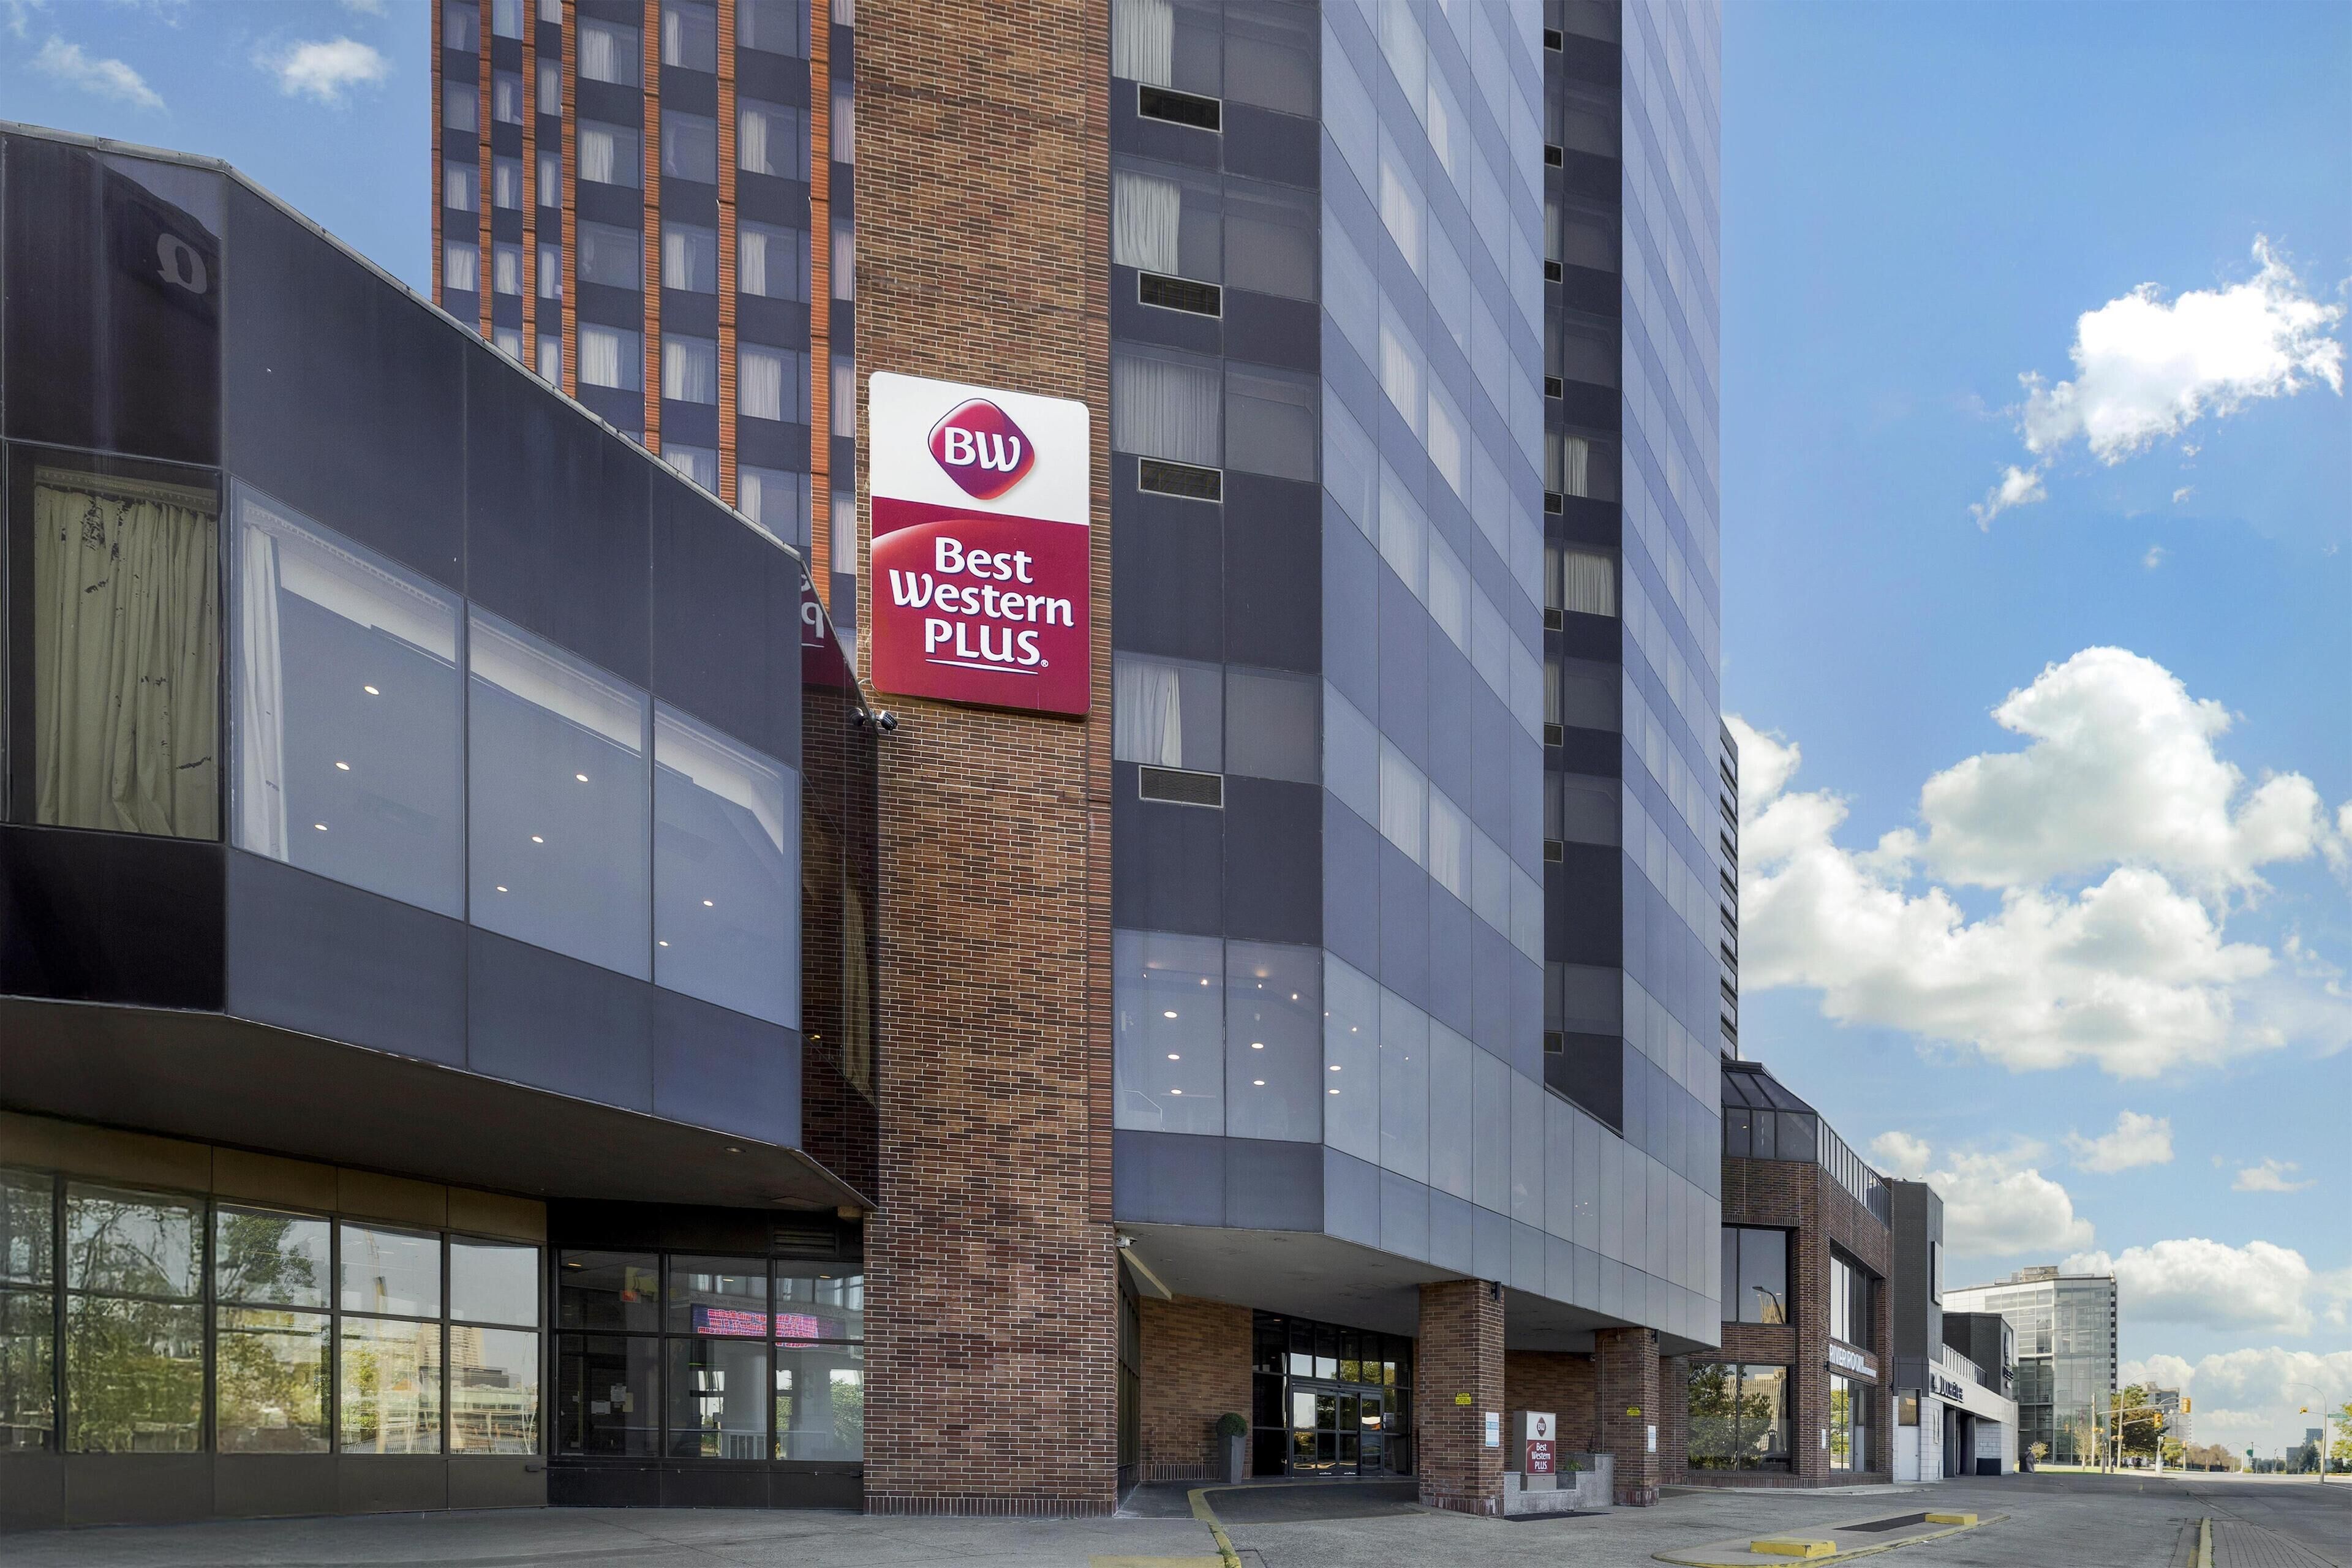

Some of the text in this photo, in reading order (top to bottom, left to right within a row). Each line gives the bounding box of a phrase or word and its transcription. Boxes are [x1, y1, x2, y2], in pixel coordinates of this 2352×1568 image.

[944, 426, 1020, 472] BW
[935, 536, 1033, 584] Best
[888, 568, 1074, 627] Western
[1829, 1344, 1846, 1367] RIVER
[1531, 1451, 1551, 1460] Western
[1536, 1442, 1547, 1451] Best
